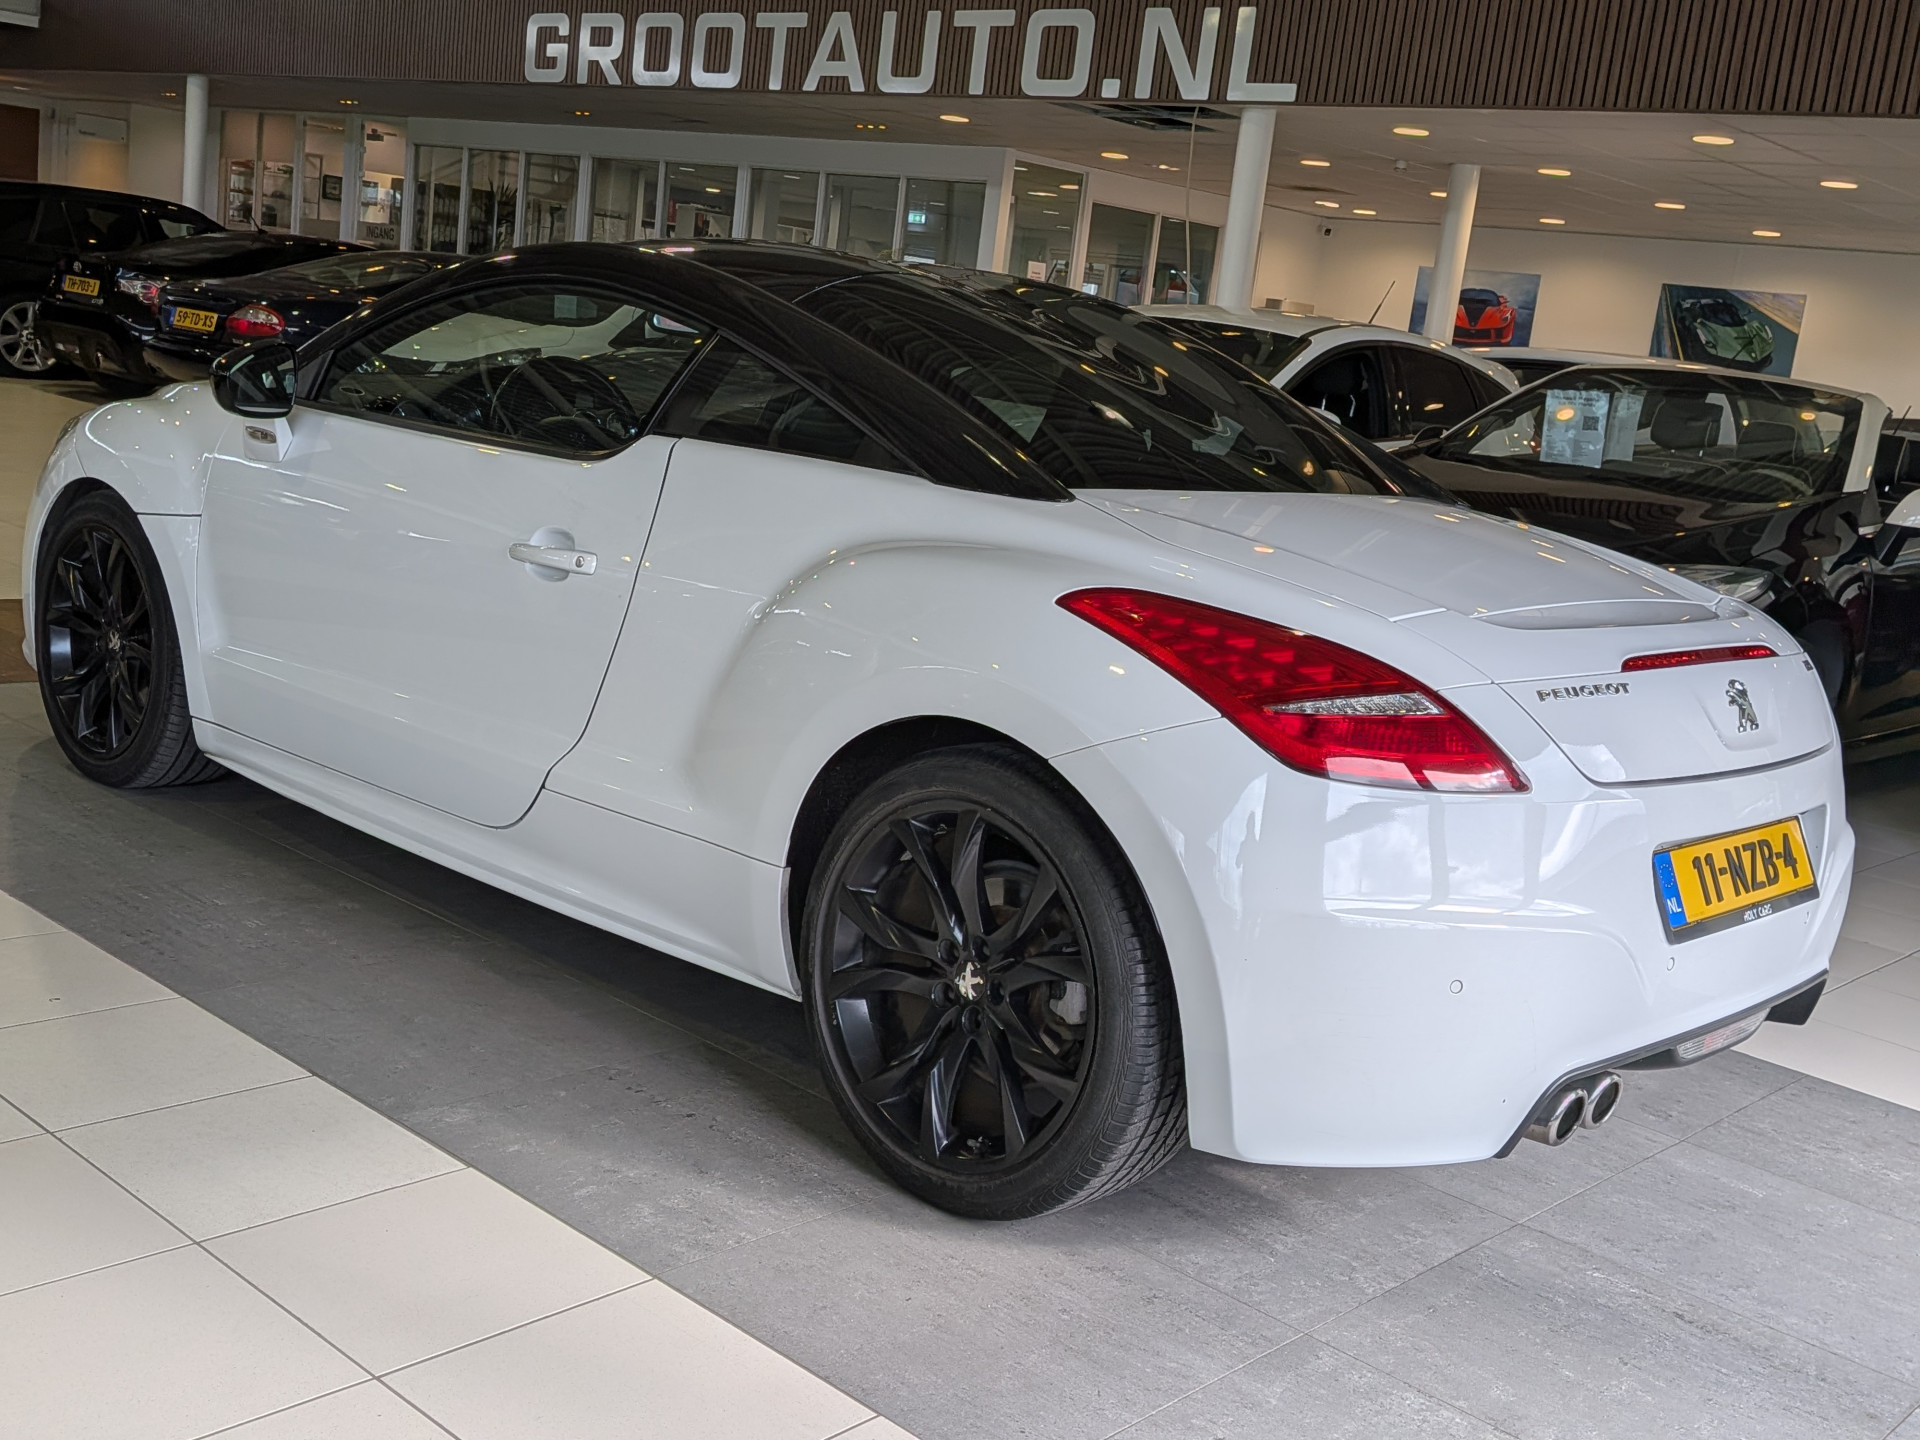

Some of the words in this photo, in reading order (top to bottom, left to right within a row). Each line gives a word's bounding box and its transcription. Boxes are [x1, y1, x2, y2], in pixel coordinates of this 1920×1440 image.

[525, 6, 1298, 101] GROOTAUTO.NL
[366, 225, 395, 240] INGANG
[176, 310, 215, 328] 59-TD-XS
[1536, 682, 1630, 702] PEUGEOT
[1691, 832, 1800, 906] 11-NZB-4
[1666, 897, 1682, 914] NL
